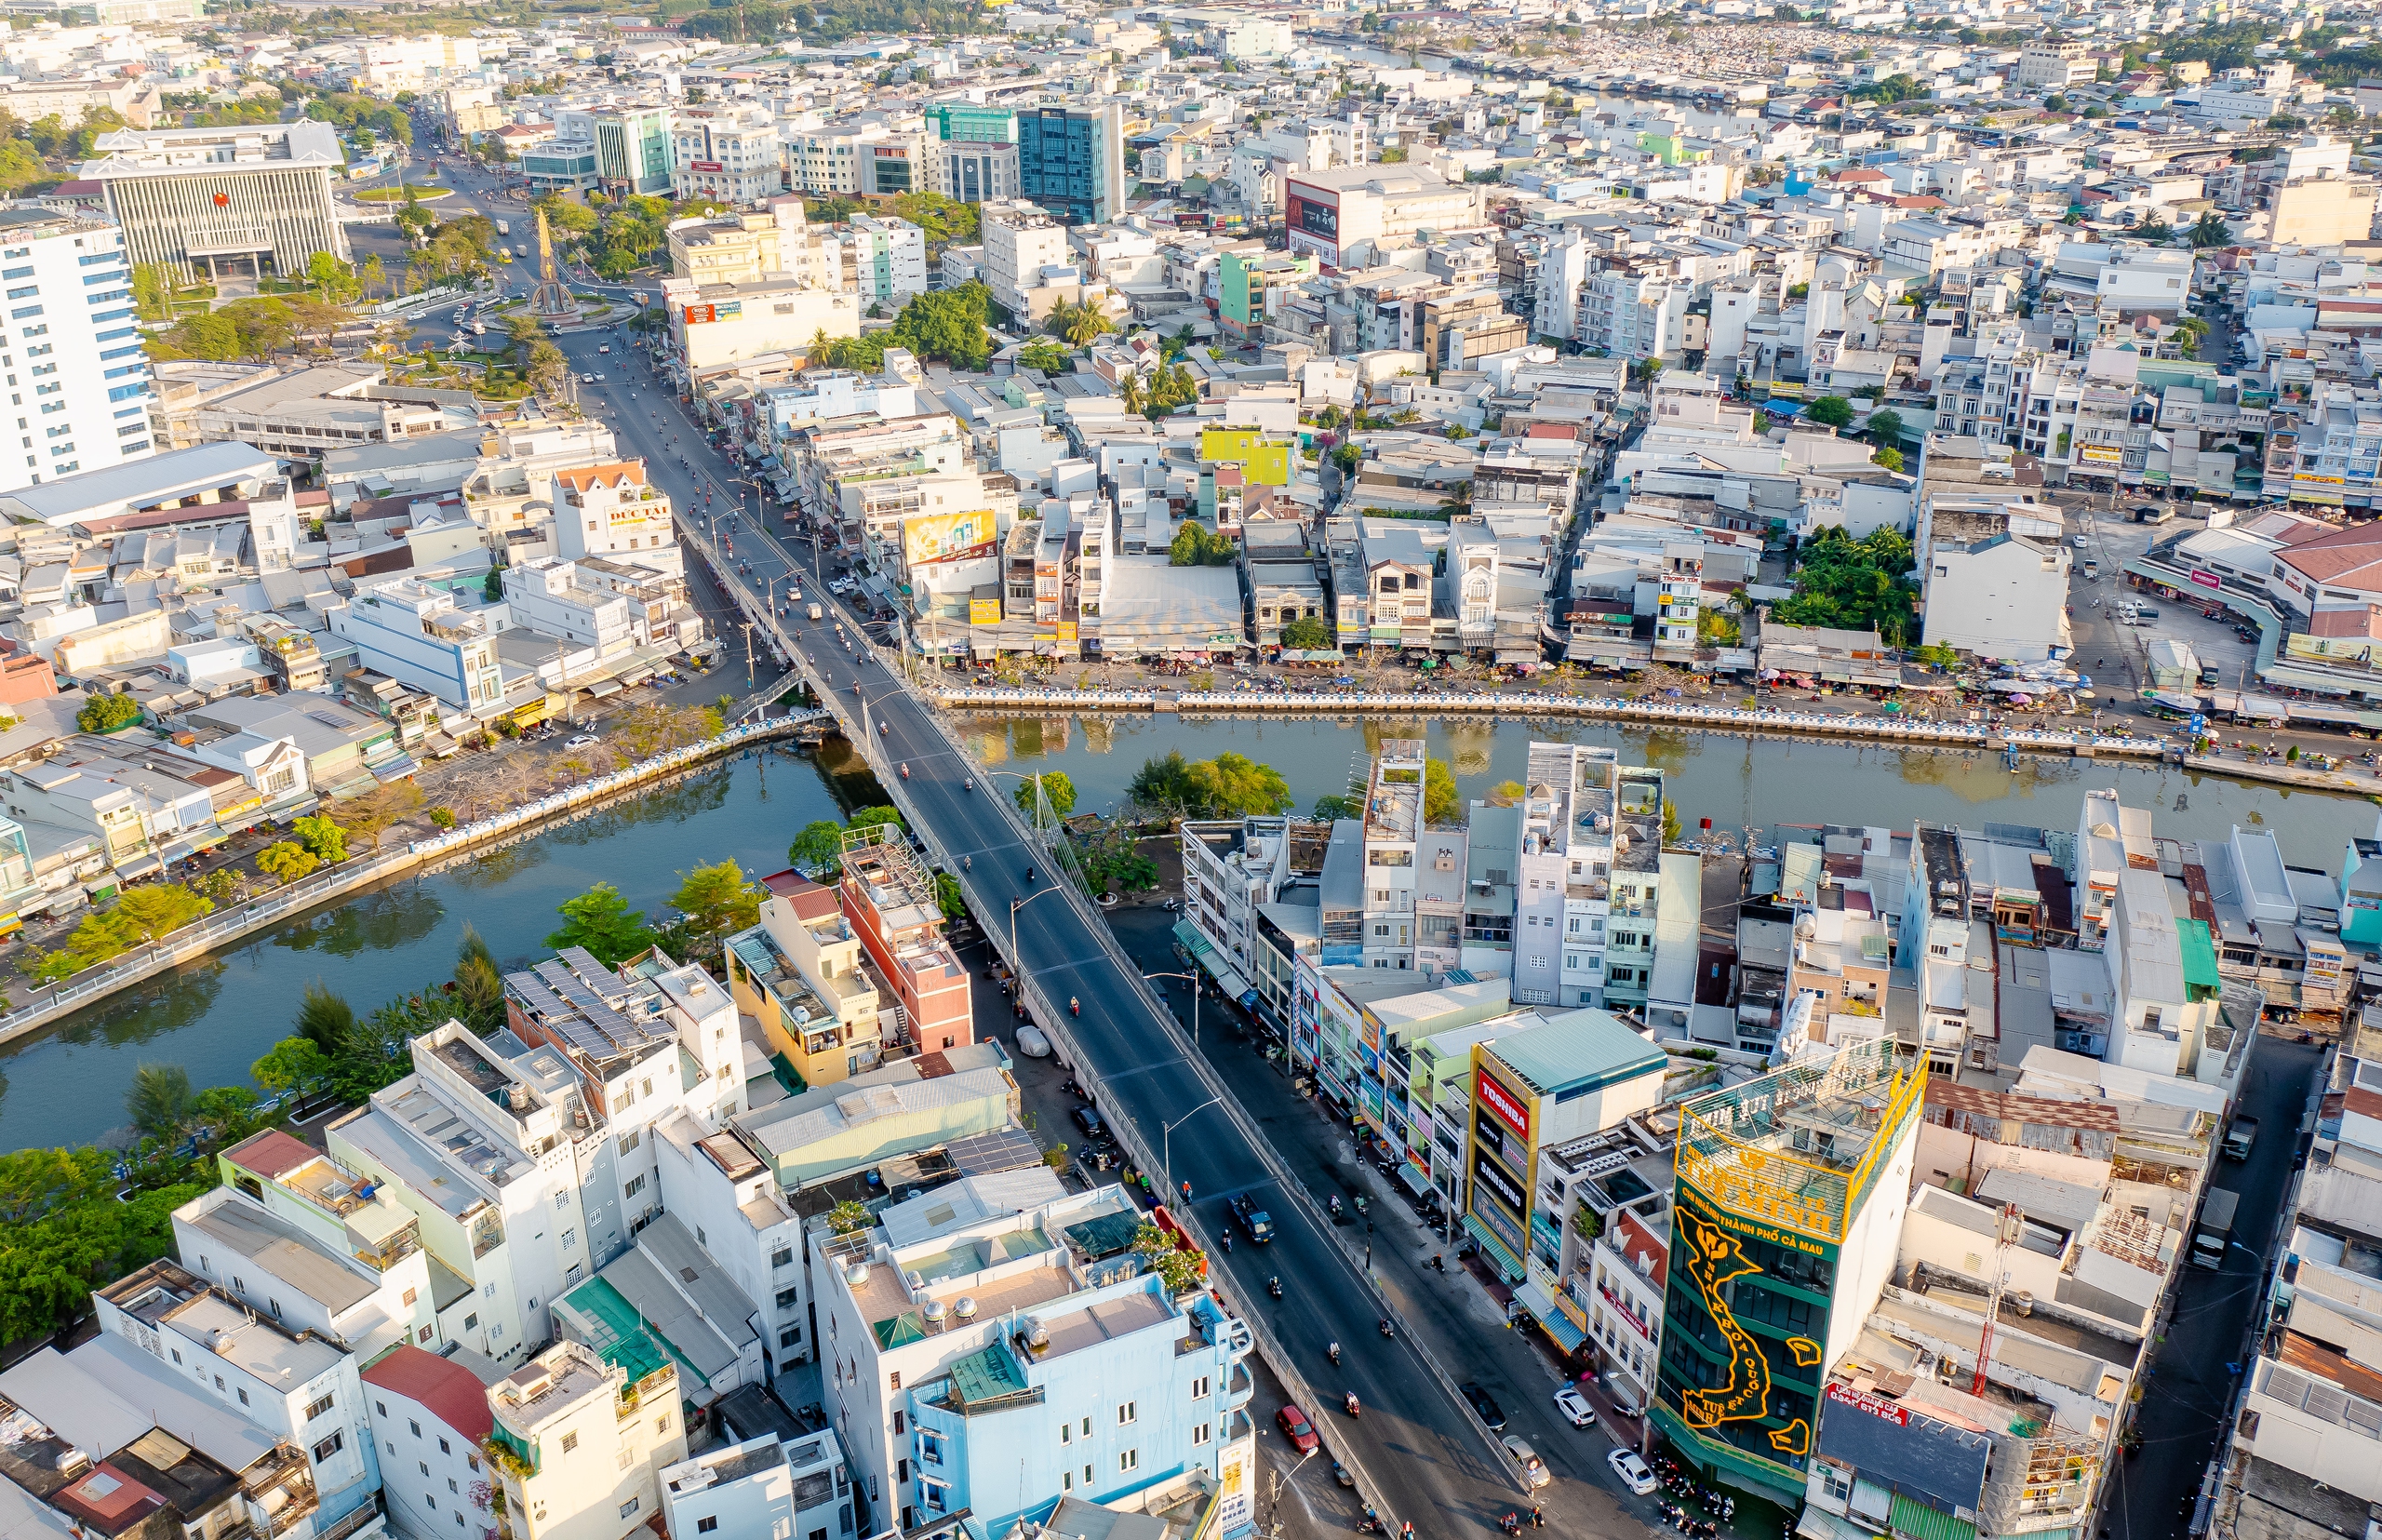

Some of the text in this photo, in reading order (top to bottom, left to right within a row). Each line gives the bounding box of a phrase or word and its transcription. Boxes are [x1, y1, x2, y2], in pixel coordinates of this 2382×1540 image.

[610, 504, 667, 520] ĐỨC TÀI
[1482, 1081, 1526, 1131] TOSHIBA
[1479, 1121, 1500, 1144] SONY
[1480, 1161, 1521, 1208] SAMSUNG
[1683, 1155, 1833, 1234] TUỆ MINH
[1686, 1144, 1710, 1167] NHA
[1712, 1165, 1749, 1190] KHOA
[1754, 1178, 1800, 1203] QUỐC
[1805, 1194, 1827, 1212] TẾ
[1495, 1219, 1519, 1248] QUANG
[1681, 1186, 1824, 1256] CHI NHÁNH THÀNH PHỐ CÀ MAU
[1704, 1262, 1760, 1411] NHA KHOA QUỐC TẾ
[1688, 1399, 1714, 1424] MINH
[1702, 1399, 1725, 1418] TUỆ
[1853, 1391, 1861, 1399] HỆ
